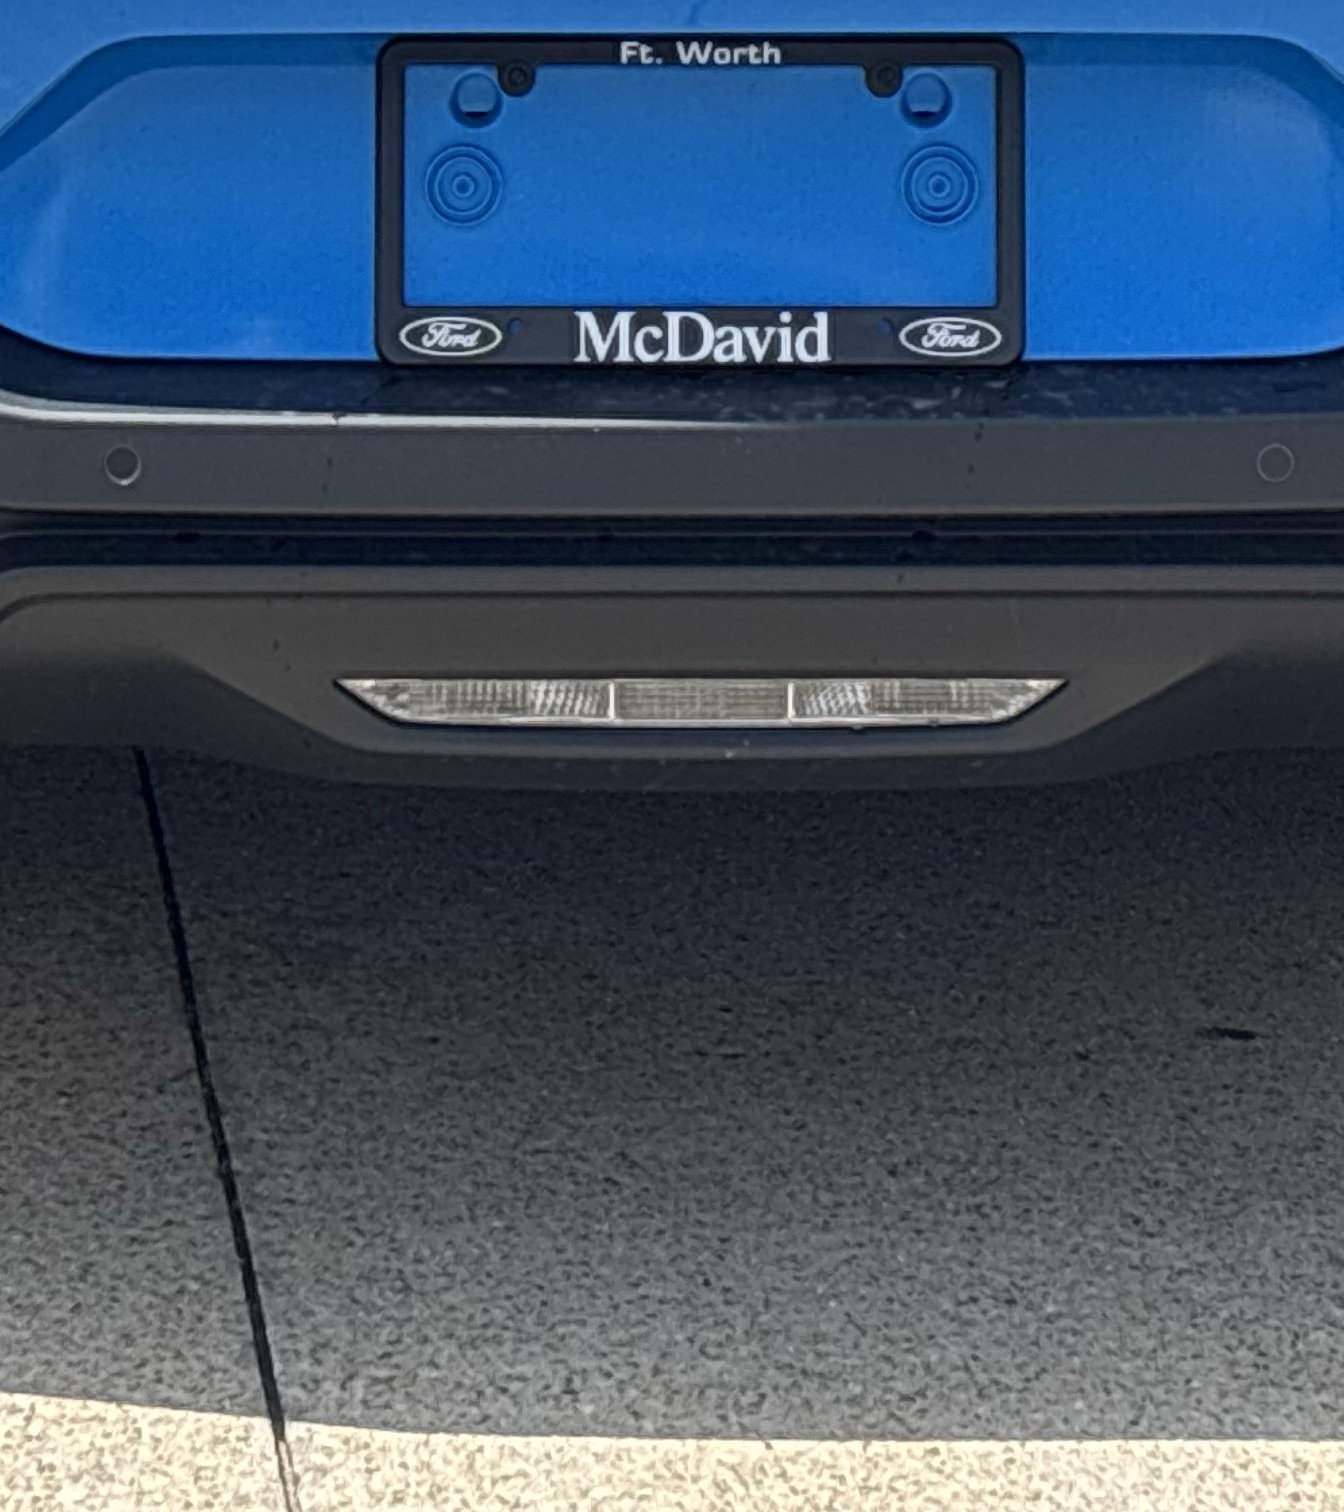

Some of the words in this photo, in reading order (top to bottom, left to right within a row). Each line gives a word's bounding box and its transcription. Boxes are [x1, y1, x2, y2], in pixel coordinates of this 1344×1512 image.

[620, 41, 663, 65] Ft.
[676, 41, 781, 65] Worth
[421, 322, 482, 348] Ford
[574, 311, 832, 363] McDavid
[921, 322, 981, 348] Ford
